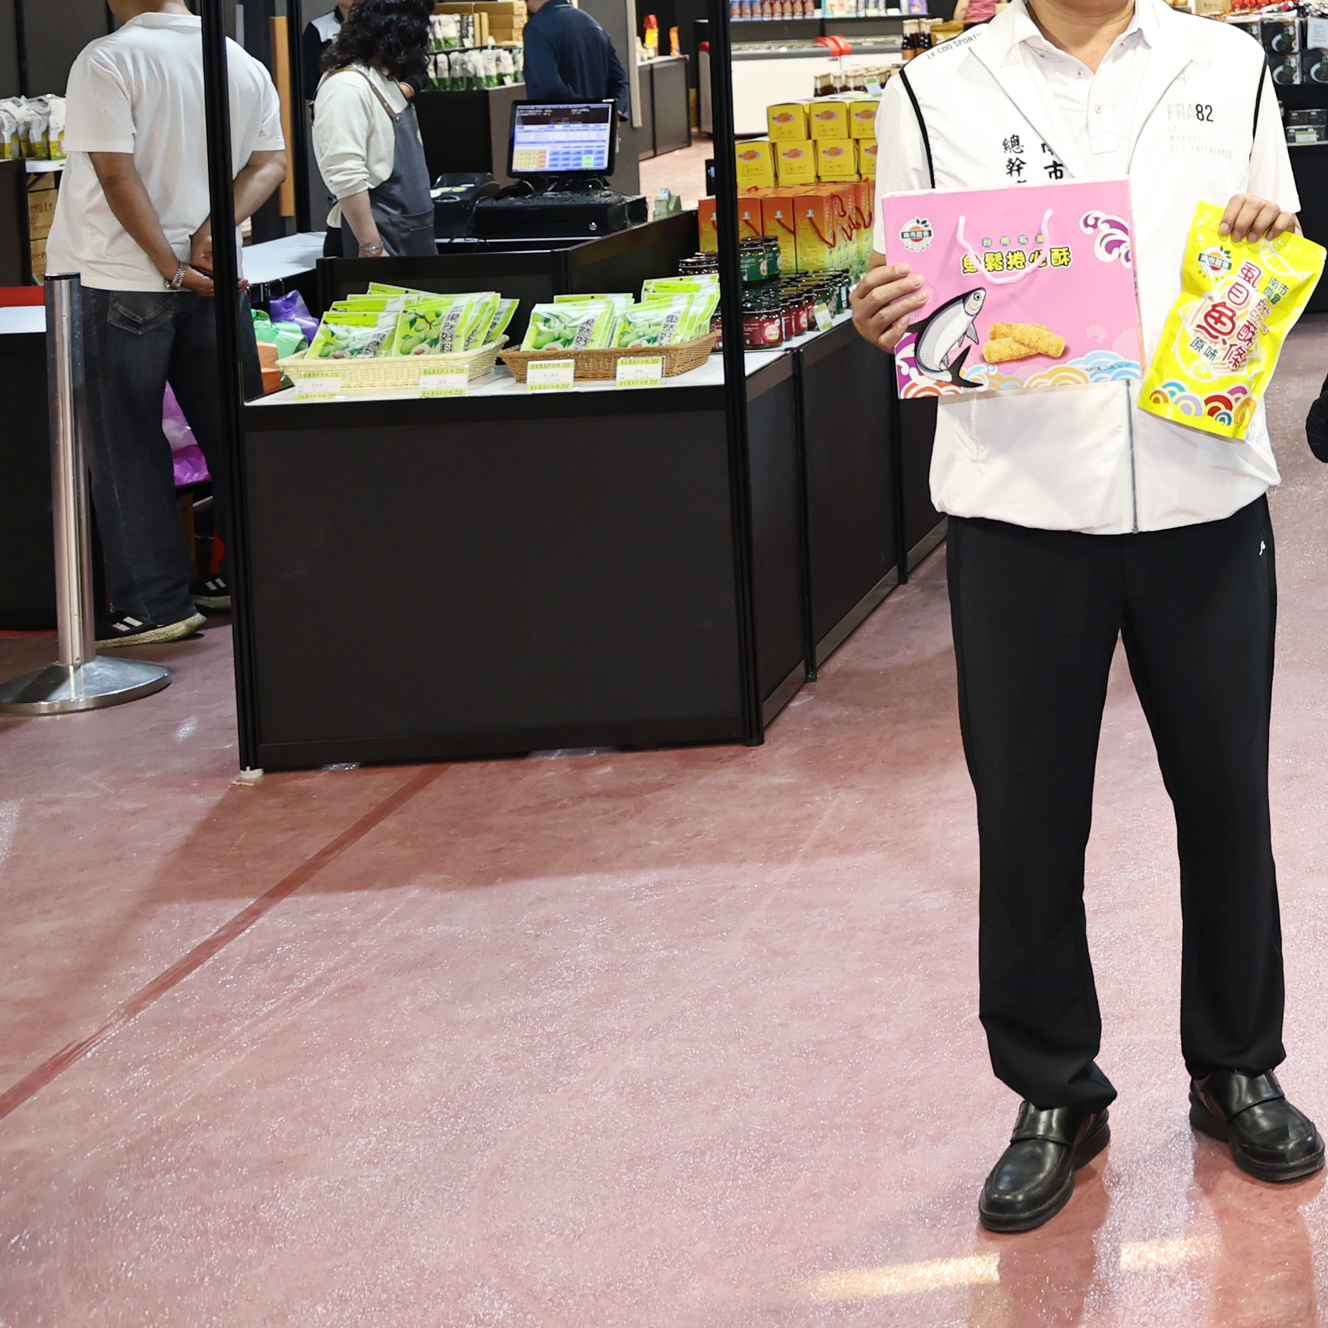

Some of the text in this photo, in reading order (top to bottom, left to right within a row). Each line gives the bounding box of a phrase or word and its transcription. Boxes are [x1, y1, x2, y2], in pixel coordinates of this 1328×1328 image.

[1002, 134, 1027, 183] 總幹
[1041, 143, 1064, 180] 市
[1189, 337, 1219, 362] 原味
